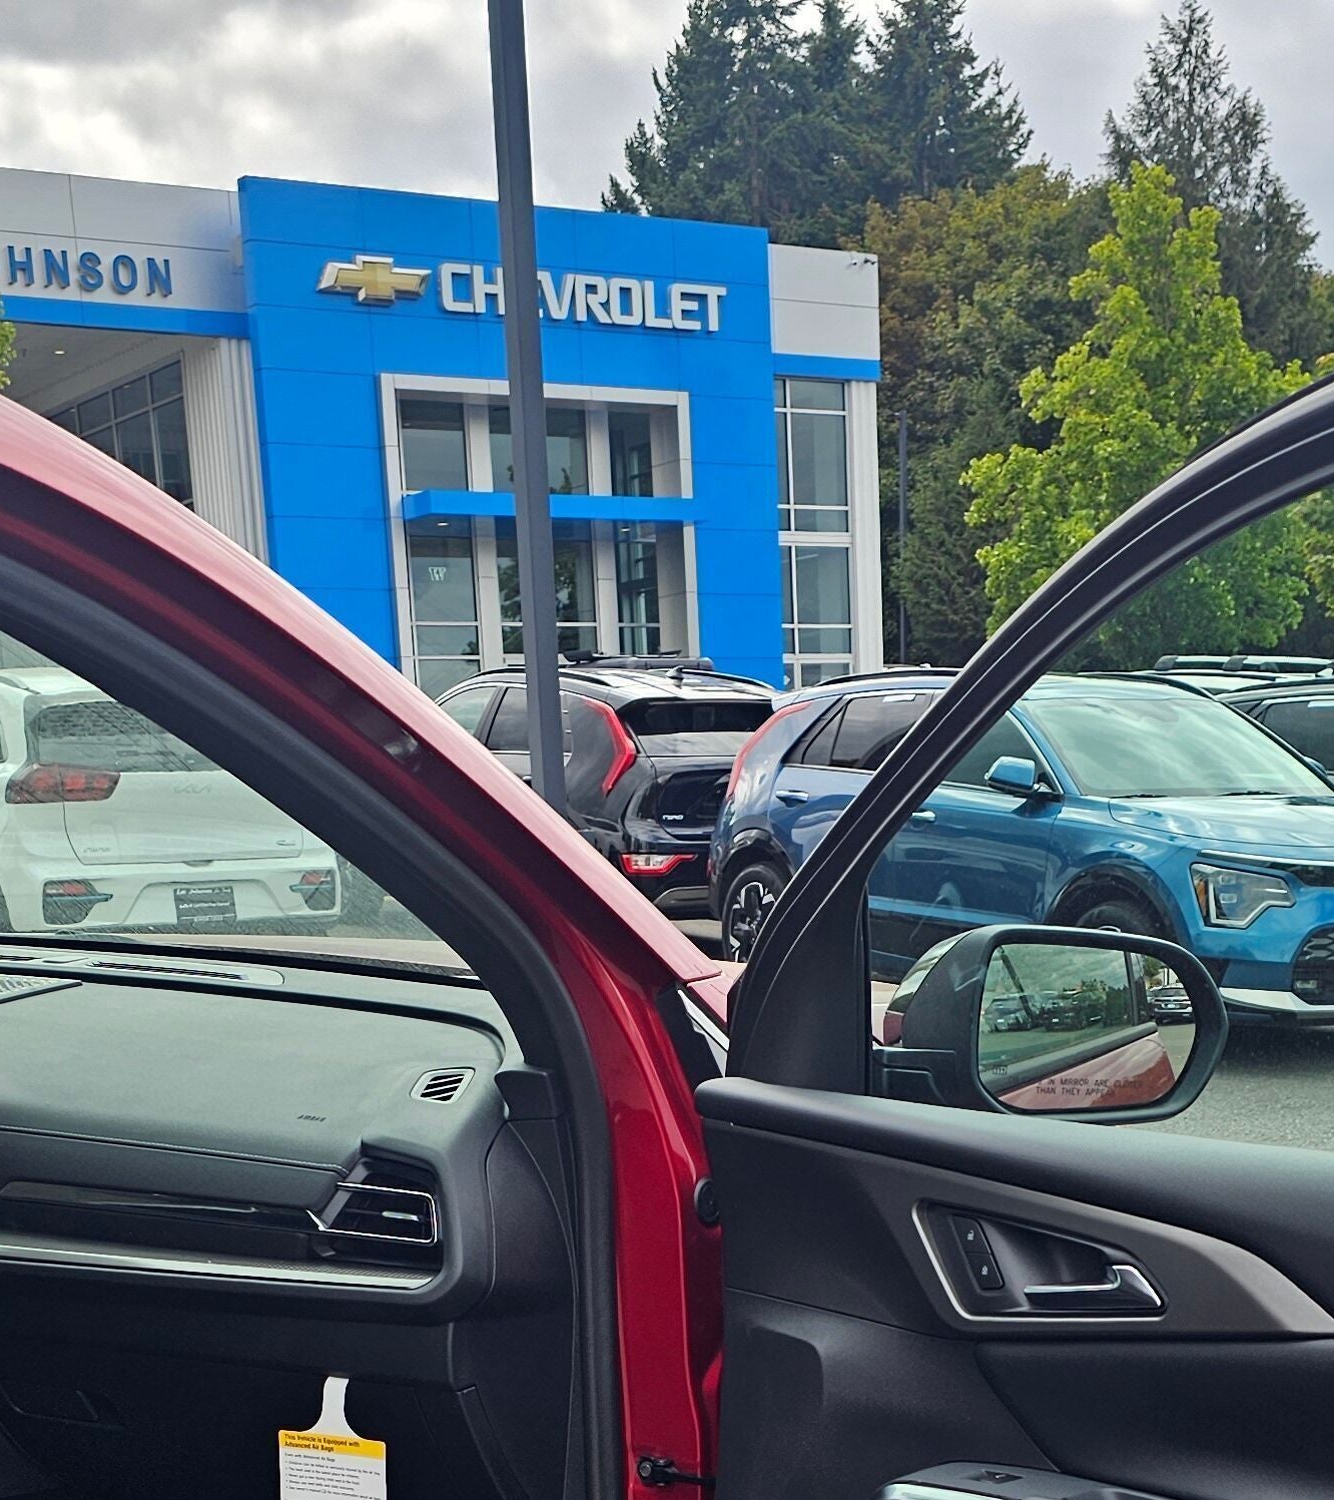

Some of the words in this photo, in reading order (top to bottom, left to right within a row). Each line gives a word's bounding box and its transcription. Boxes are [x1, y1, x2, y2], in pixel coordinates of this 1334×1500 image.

[438, 262, 727, 333] CHVROLET
[1060, 1078, 1089, 1087] MIRROR
[1094, 1079, 1109, 1087] ARE
[1036, 1086, 1056, 1095] THAN
[1061, 1087, 1080, 1096] THEY
